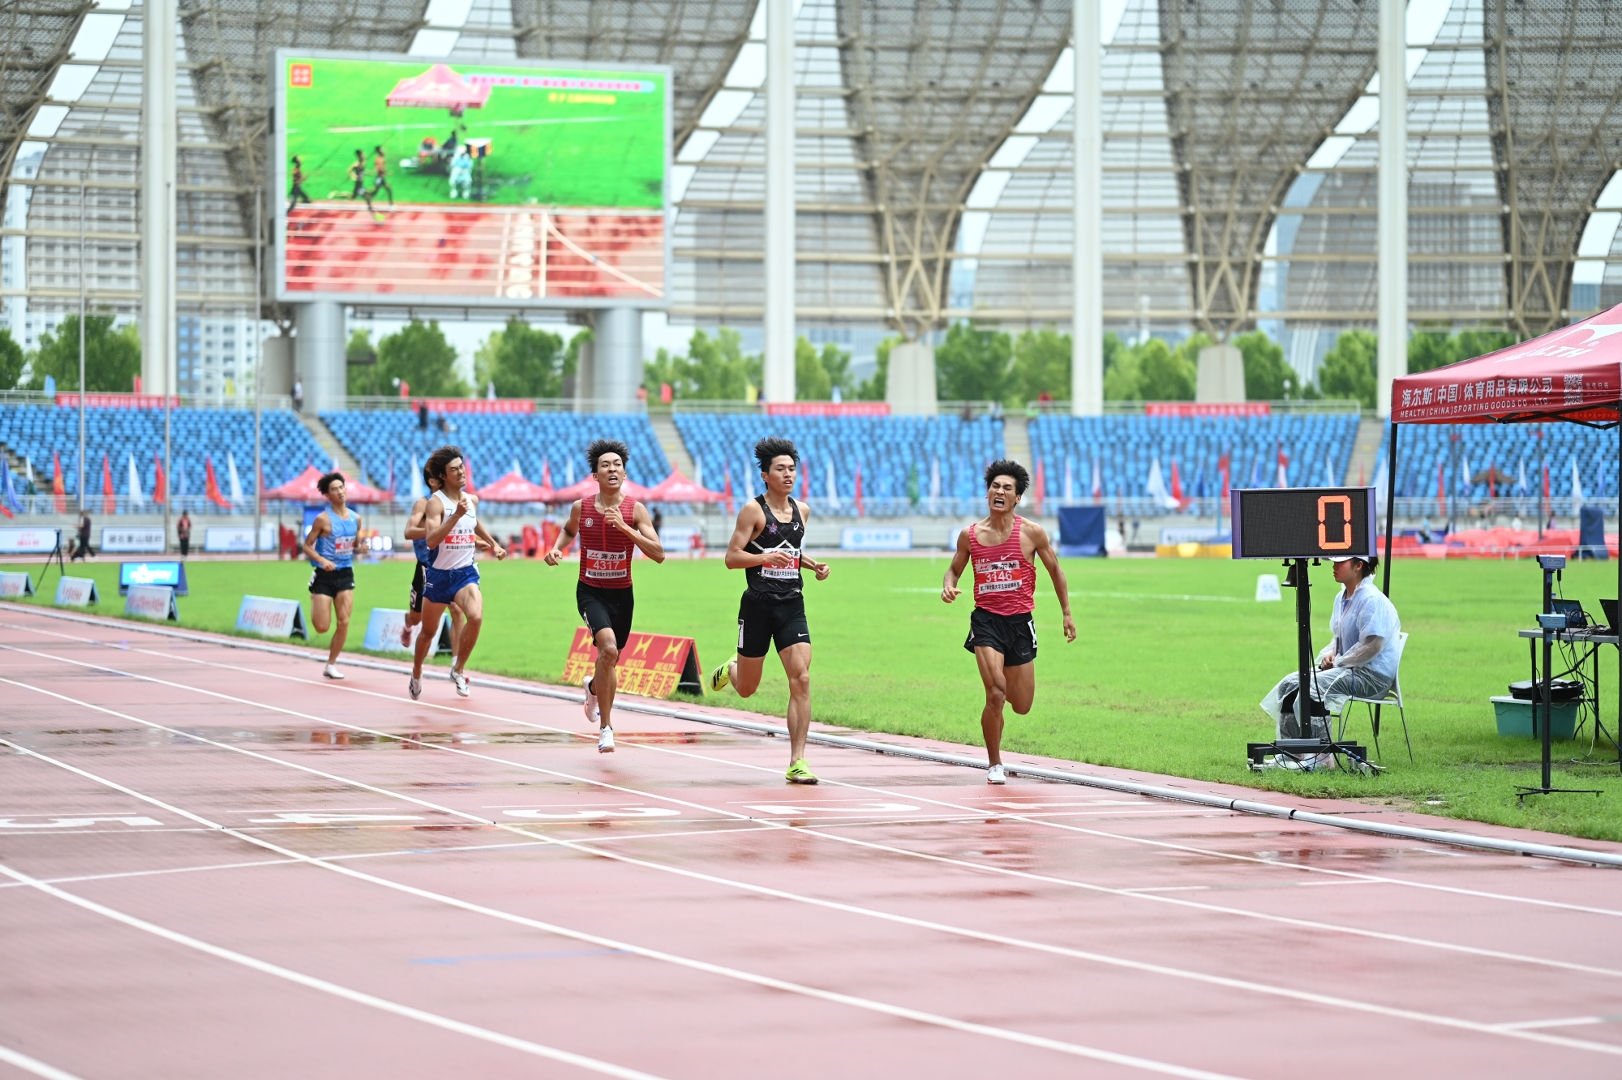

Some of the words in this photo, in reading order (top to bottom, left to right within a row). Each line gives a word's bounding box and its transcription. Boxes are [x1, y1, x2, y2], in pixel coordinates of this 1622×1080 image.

[1318, 495, 1351, 549] 0
[450, 535, 471, 544] 4426
[593, 560, 620, 570] 4317
[985, 570, 1013, 583] 3146
[502, 808, 681, 818] 3
[742, 804, 921, 814] 2
